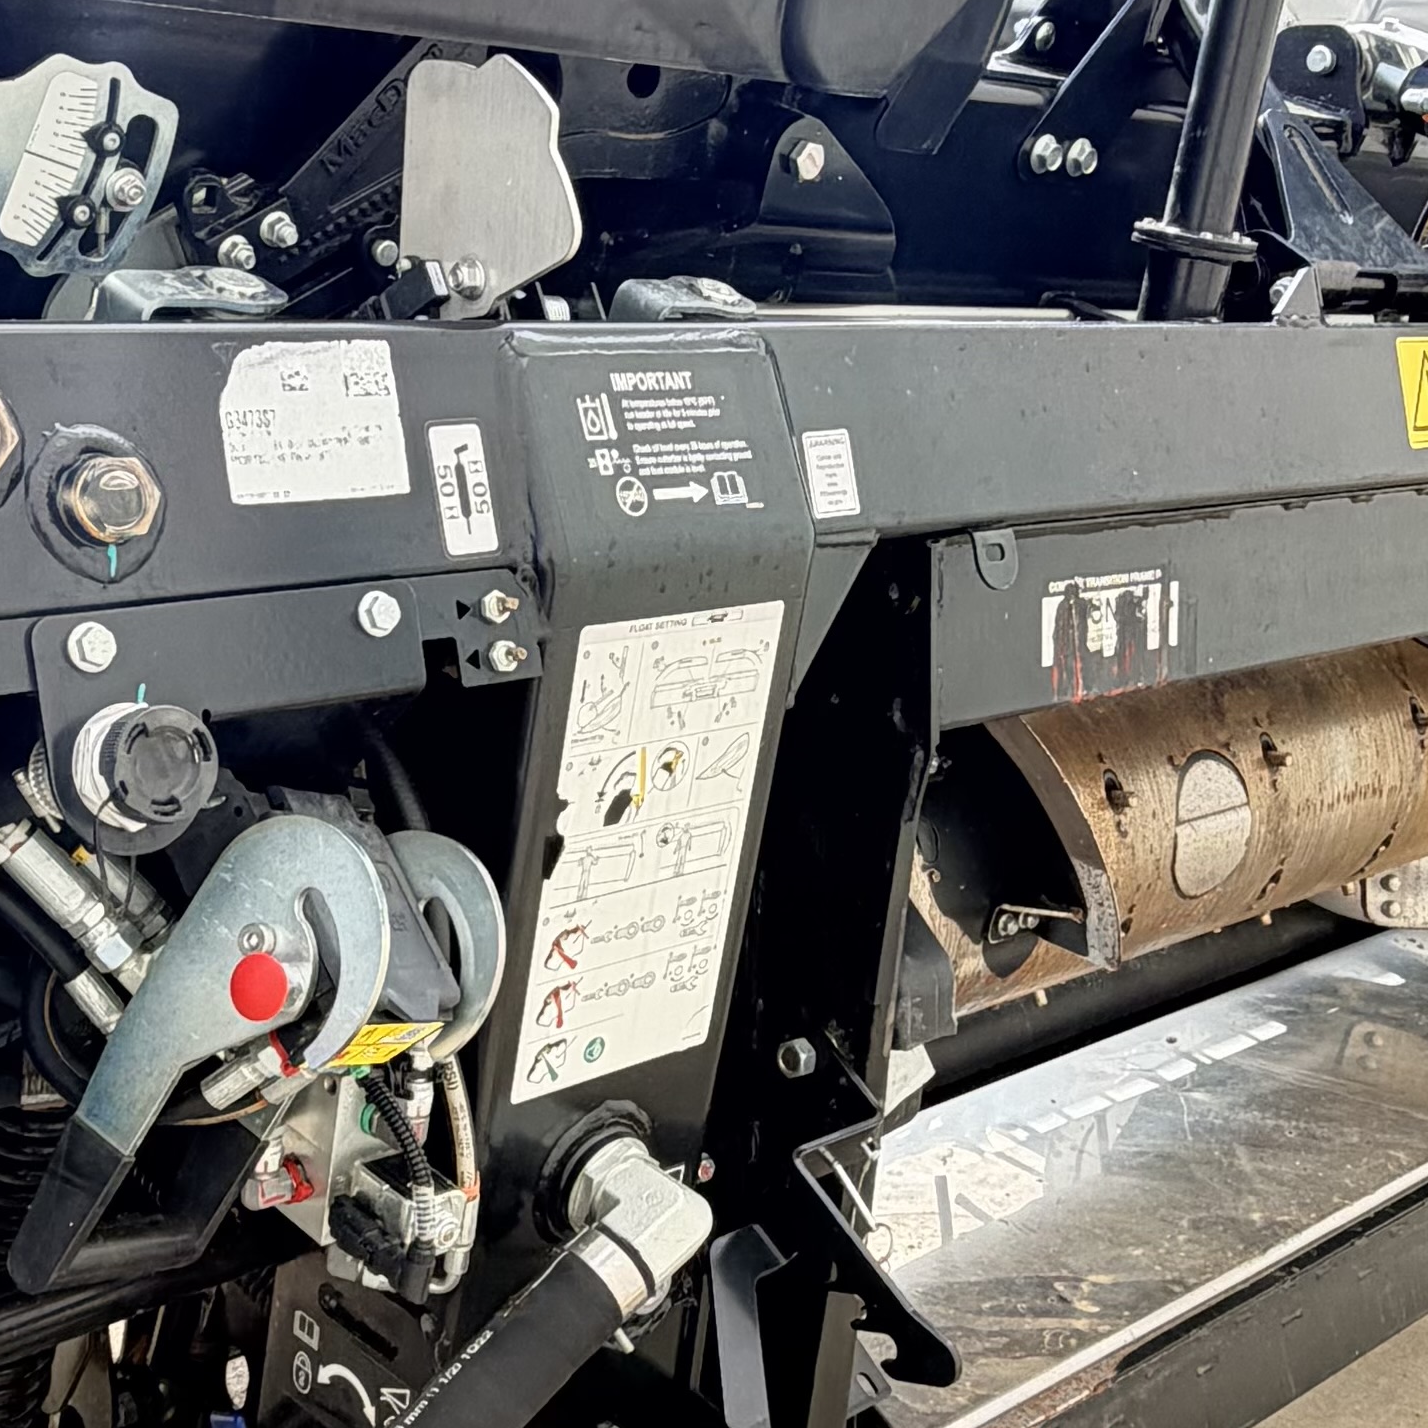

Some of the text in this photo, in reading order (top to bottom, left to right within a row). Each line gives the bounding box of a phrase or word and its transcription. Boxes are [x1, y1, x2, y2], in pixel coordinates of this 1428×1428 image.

[610, 371, 693, 392] IMPORTANT
[435, 463, 456, 498] 50
[472, 481, 491, 516] 50
[404, 1400, 429, 1426] mm
